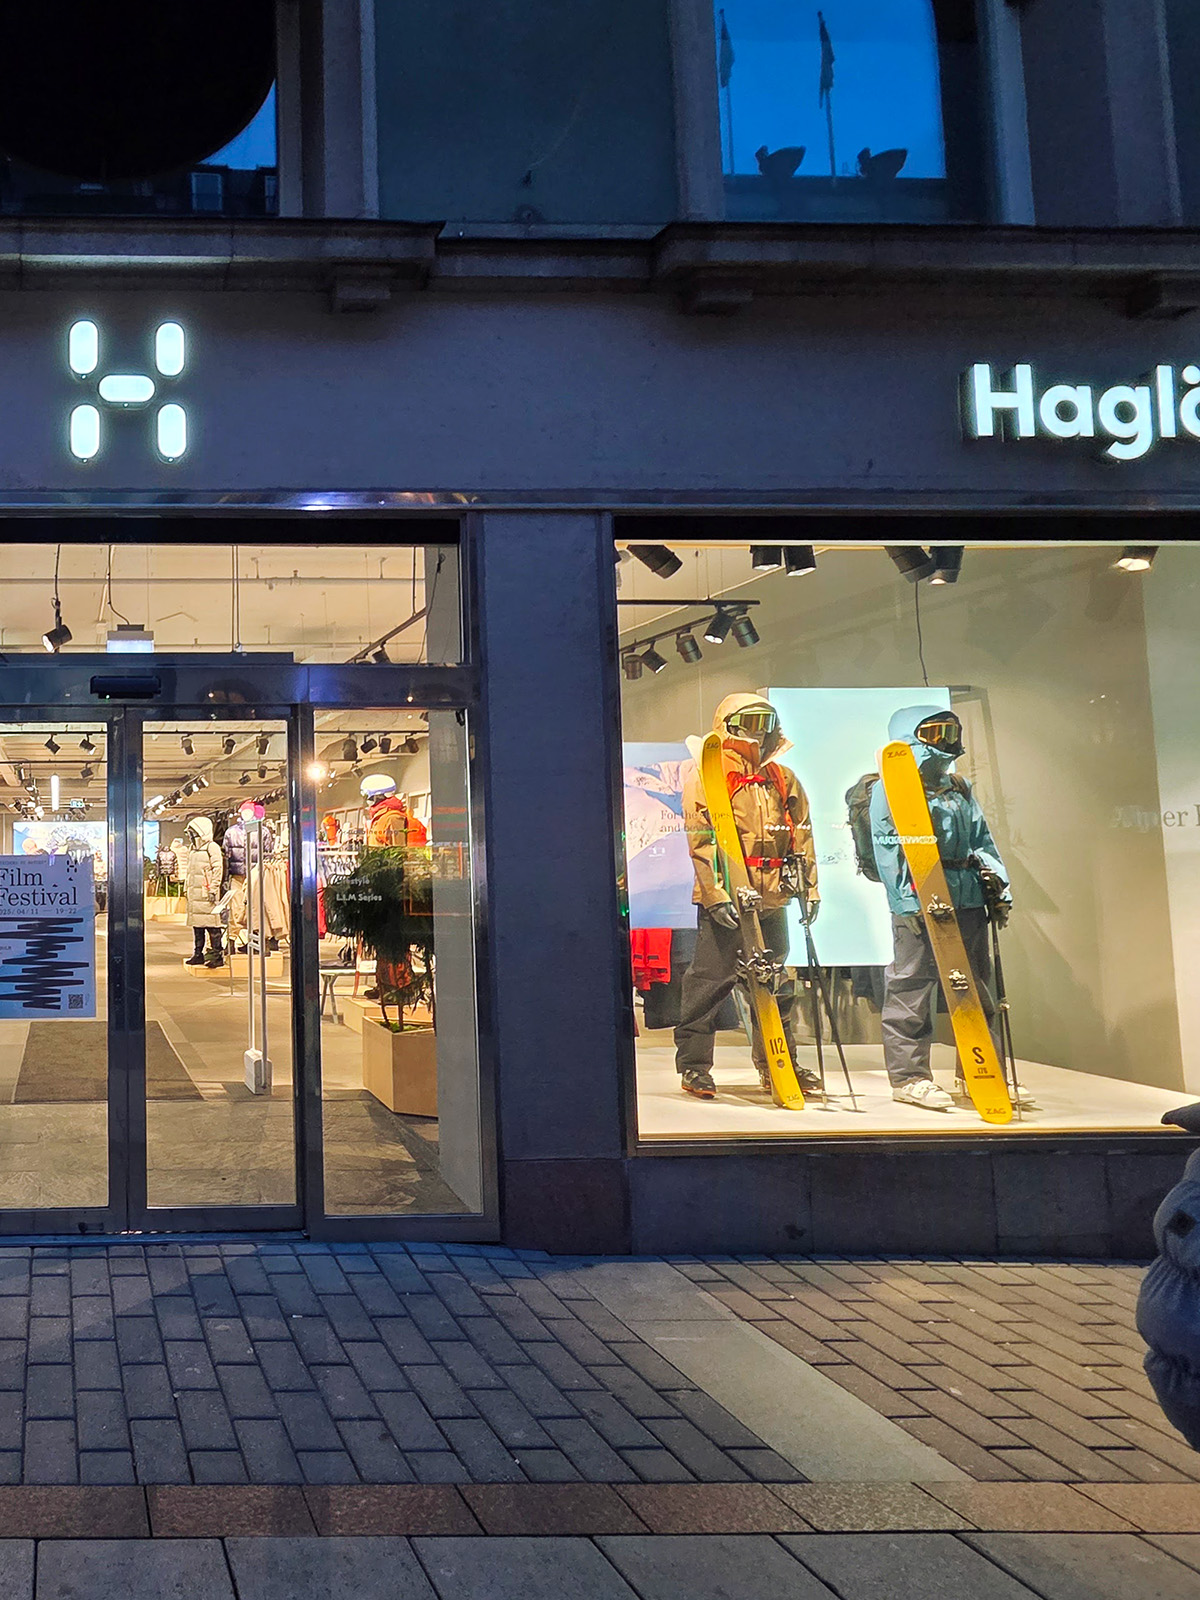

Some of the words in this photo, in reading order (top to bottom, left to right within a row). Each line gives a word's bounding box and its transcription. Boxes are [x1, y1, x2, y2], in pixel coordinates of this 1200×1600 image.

[887, 749, 908, 759] ZAG
[660, 810, 680, 820] For
[700, 810, 731, 822] sopes
[660, 822, 681, 833] and
[336, 893, 356, 901] L.I.M
[358, 893, 382, 902] Series
[769, 1037, 786, 1055] 112
[972, 1047, 985, 1064] S
